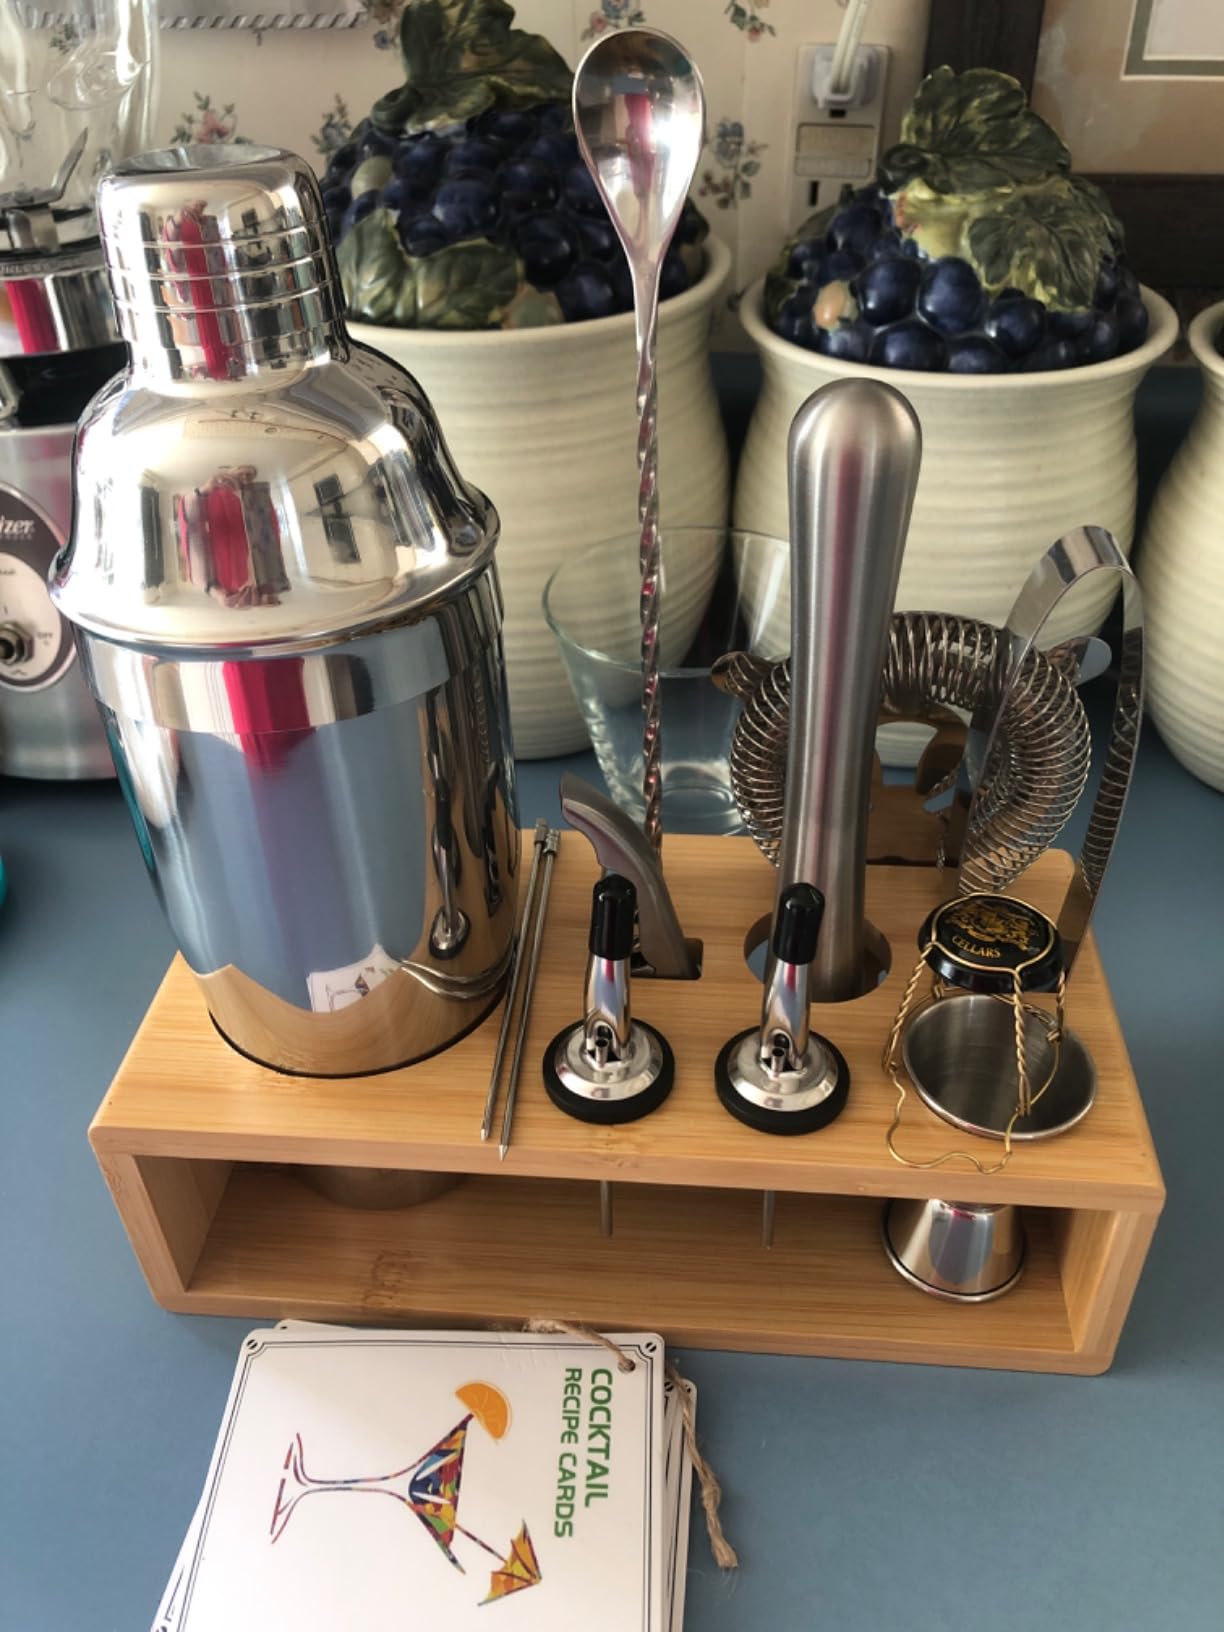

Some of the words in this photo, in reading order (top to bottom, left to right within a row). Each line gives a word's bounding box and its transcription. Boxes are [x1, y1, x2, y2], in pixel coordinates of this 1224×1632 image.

[952, 935, 1001, 958] CELLARS
[560, 1368, 583, 1444] RECIPE
[585, 1368, 613, 1508] COCKTAIL
[554, 1453, 577, 1538] CARDS
